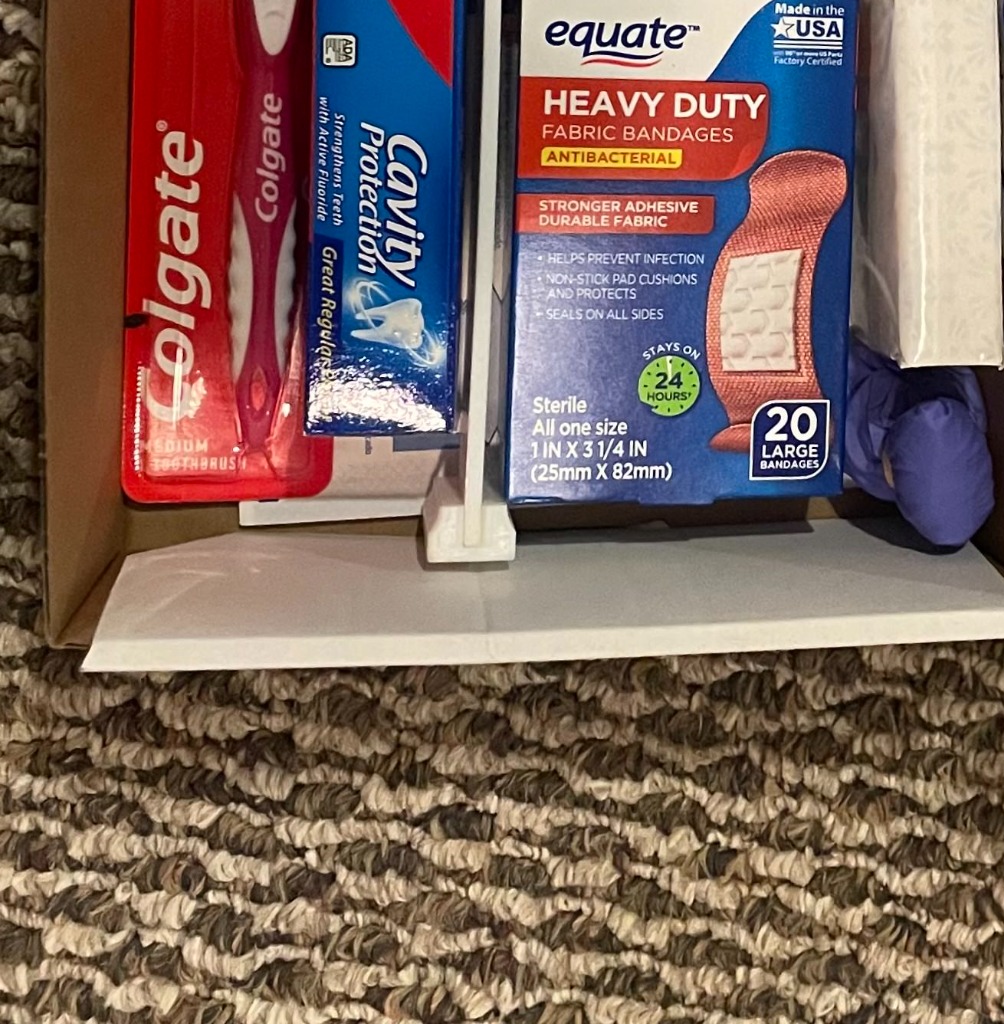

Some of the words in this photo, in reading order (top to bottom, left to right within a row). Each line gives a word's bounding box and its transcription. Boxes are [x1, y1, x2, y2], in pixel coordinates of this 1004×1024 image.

[775, 3, 811, 15] Made
[812, 4, 824, 15] in
[826, 4, 845, 16] the
[796, 19, 841, 38] USA
[341, 39, 354, 62] ADA
[774, 56, 805, 67] Factory
[806, 57, 842, 66] Certified
[318, 96, 330, 124] with
[543, 89, 665, 117] HEAVY
[673, 93, 767, 120] DUTY
[542, 124, 617, 141] FABRIC
[622, 127, 734, 143] BANDAGES
[318, 127, 329, 166] Active
[331, 113, 346, 189] Strengthens
[255, 93, 286, 223] Colgate
[546, 150, 677, 165] ANTIBACTERIAL
[317, 169, 329, 222] Fluoride
[358, 122, 385, 274] Protection
[332, 193, 344, 226] Teeth
[372, 134, 428, 288] Cavity
[539, 200, 620, 213] STRONGER
[624, 201, 699, 214] ADHESIVE
[538, 214, 609, 227] DURABLE
[613, 216, 668, 228] FABRIC
[548, 252, 585, 265] HELPS
[587, 253, 641, 265] PREVENT
[643, 253, 705, 265] INFECTION
[322, 246, 337, 294] Great
[546, 273, 610, 285] NON-STICK
[612, 274, 636, 285] PAD
[638, 274, 698, 285] CUSHIONS
[547, 288, 573, 300] AND
[576, 288, 637, 300] PROTECTS
[546, 308, 583, 320] SEALS
[586, 308, 603, 320] ON
[606, 308, 628, 320] ALL
[631, 308, 664, 320] SIDES
[642, 342, 681, 361] STAYS
[683, 345, 701, 360] ON
[655, 371, 683, 389] 24
[532, 395, 588, 414] Sterile
[532, 418, 556, 436] All
[559, 421, 591, 435] one
[595, 418, 628, 435] size
[764, 406, 818, 442] 20
[531, 441, 538, 458] 1
[543, 441, 561, 458] IN
[566, 441, 578, 458] X
[582, 441, 593, 457] 3
[597, 438, 624, 460] 1/4
[629, 440, 647, 457] IN
[761, 444, 819, 458] LARGE
[530, 462, 592, 484] (25mm
[595, 462, 609, 480] X
[612, 461, 673, 481] 82mm)
[760, 459, 820, 470] BANDAGES
